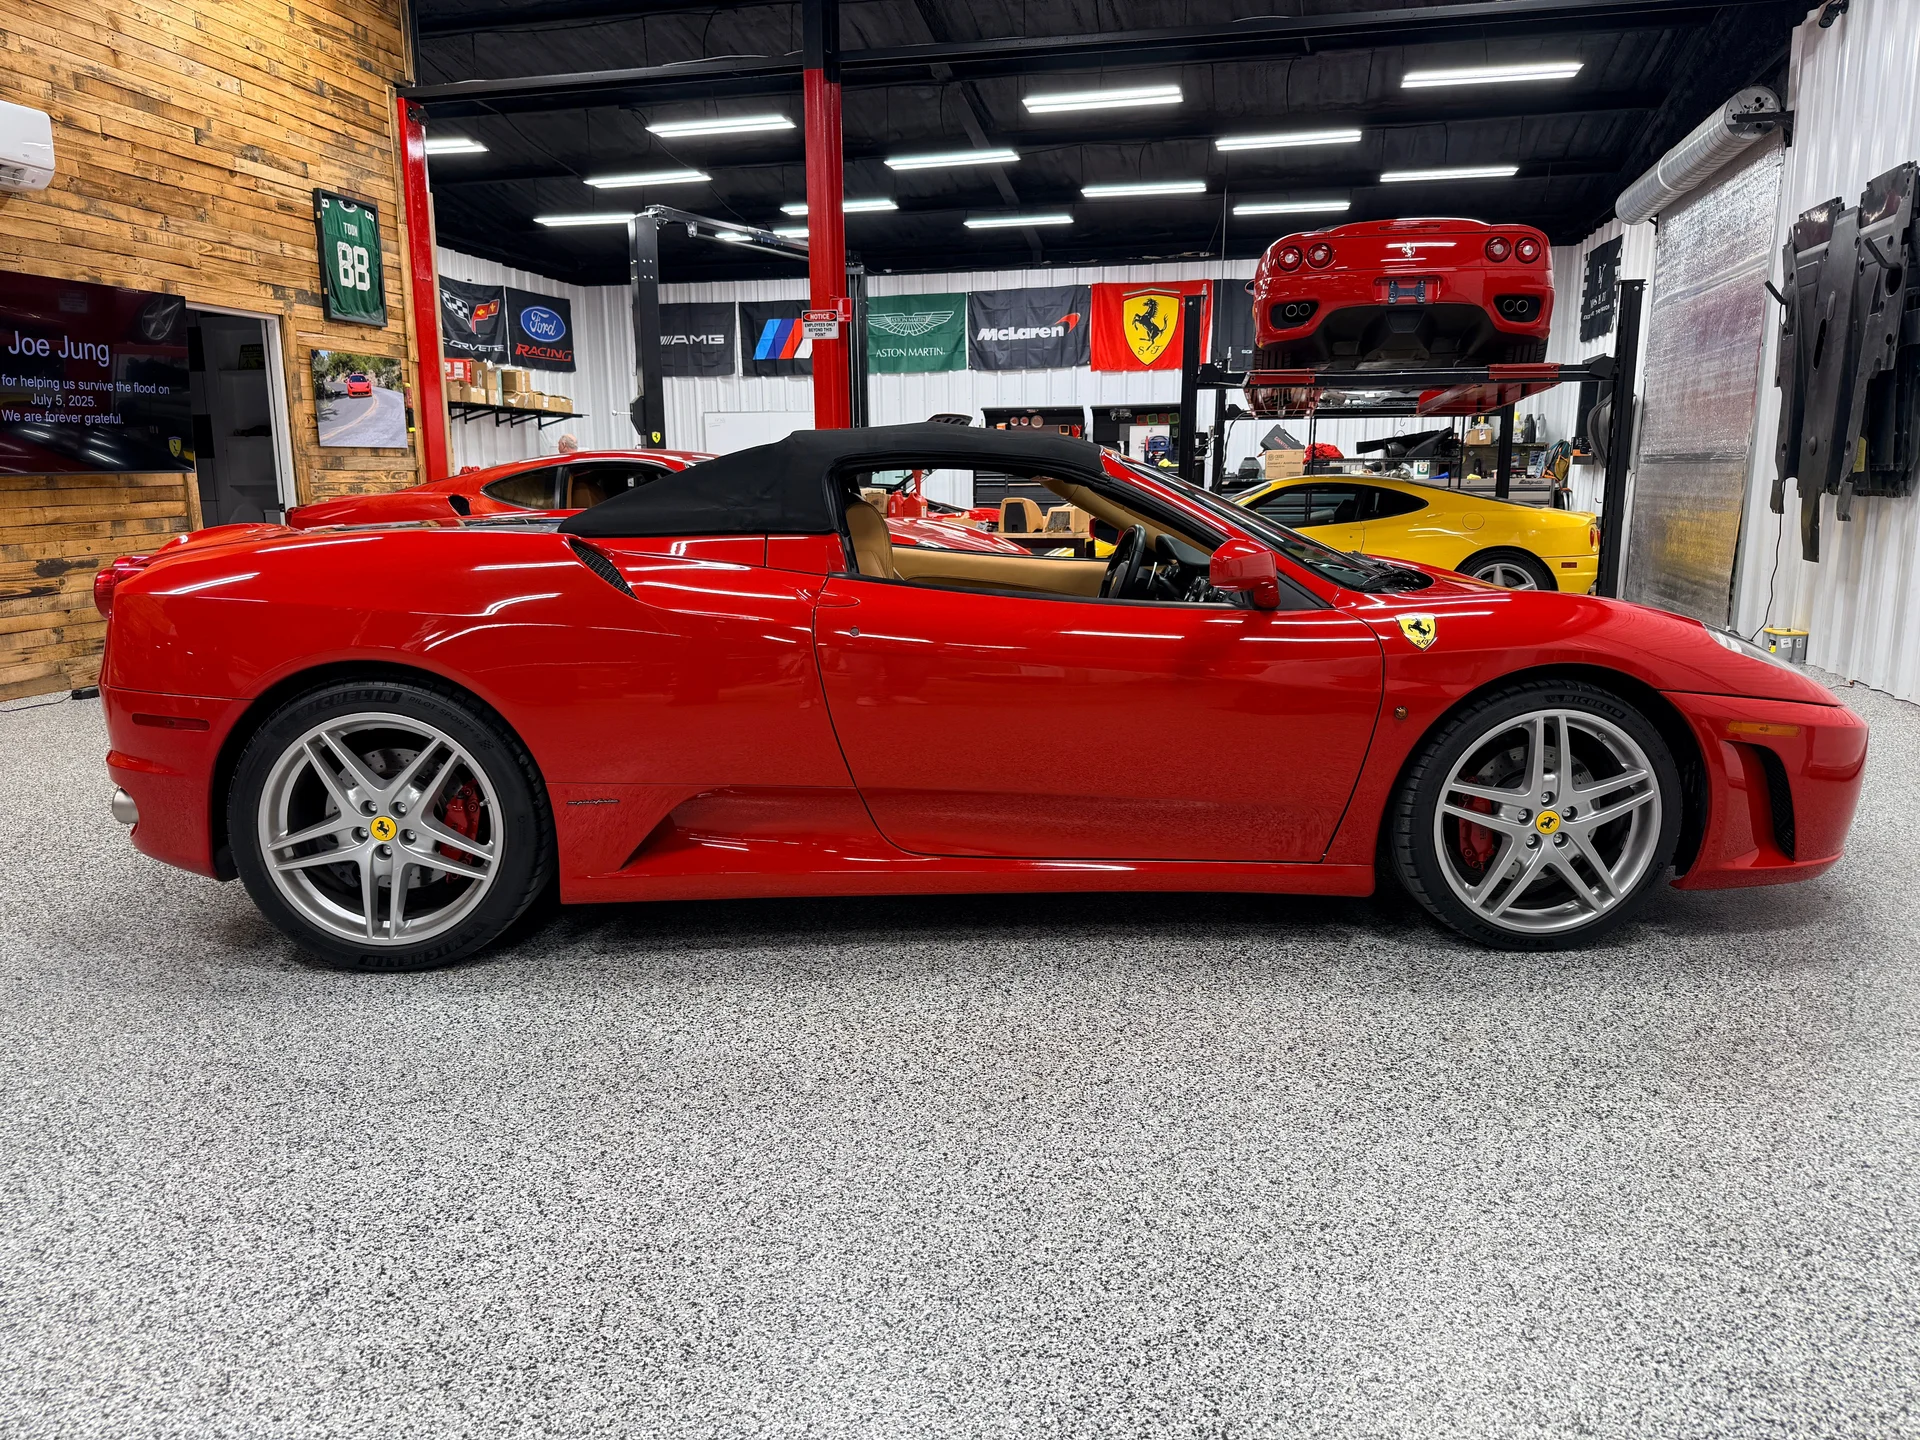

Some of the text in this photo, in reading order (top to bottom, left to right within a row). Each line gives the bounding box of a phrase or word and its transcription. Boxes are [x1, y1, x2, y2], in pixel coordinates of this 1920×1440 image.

[337, 241, 370, 291] 88
[530, 311, 557, 336] Ford
[977, 326, 1064, 341] McLaren
[8, 330, 109, 367] Joe Jung
[515, 343, 572, 362] RACING
[876, 348, 906, 358] ASTON
[1, 374, 170, 395] for helping us survive the flood on
[31, 393, 97, 408] July 5, 2025.
[1, 409, 124, 426] We are forever grateful.
[297, 690, 396, 716] MICHELIN
[408, 696, 438, 710] PILOT
[440, 708, 472, 730] SPORT
[1563, 695, 1624, 718] MICHELIN
